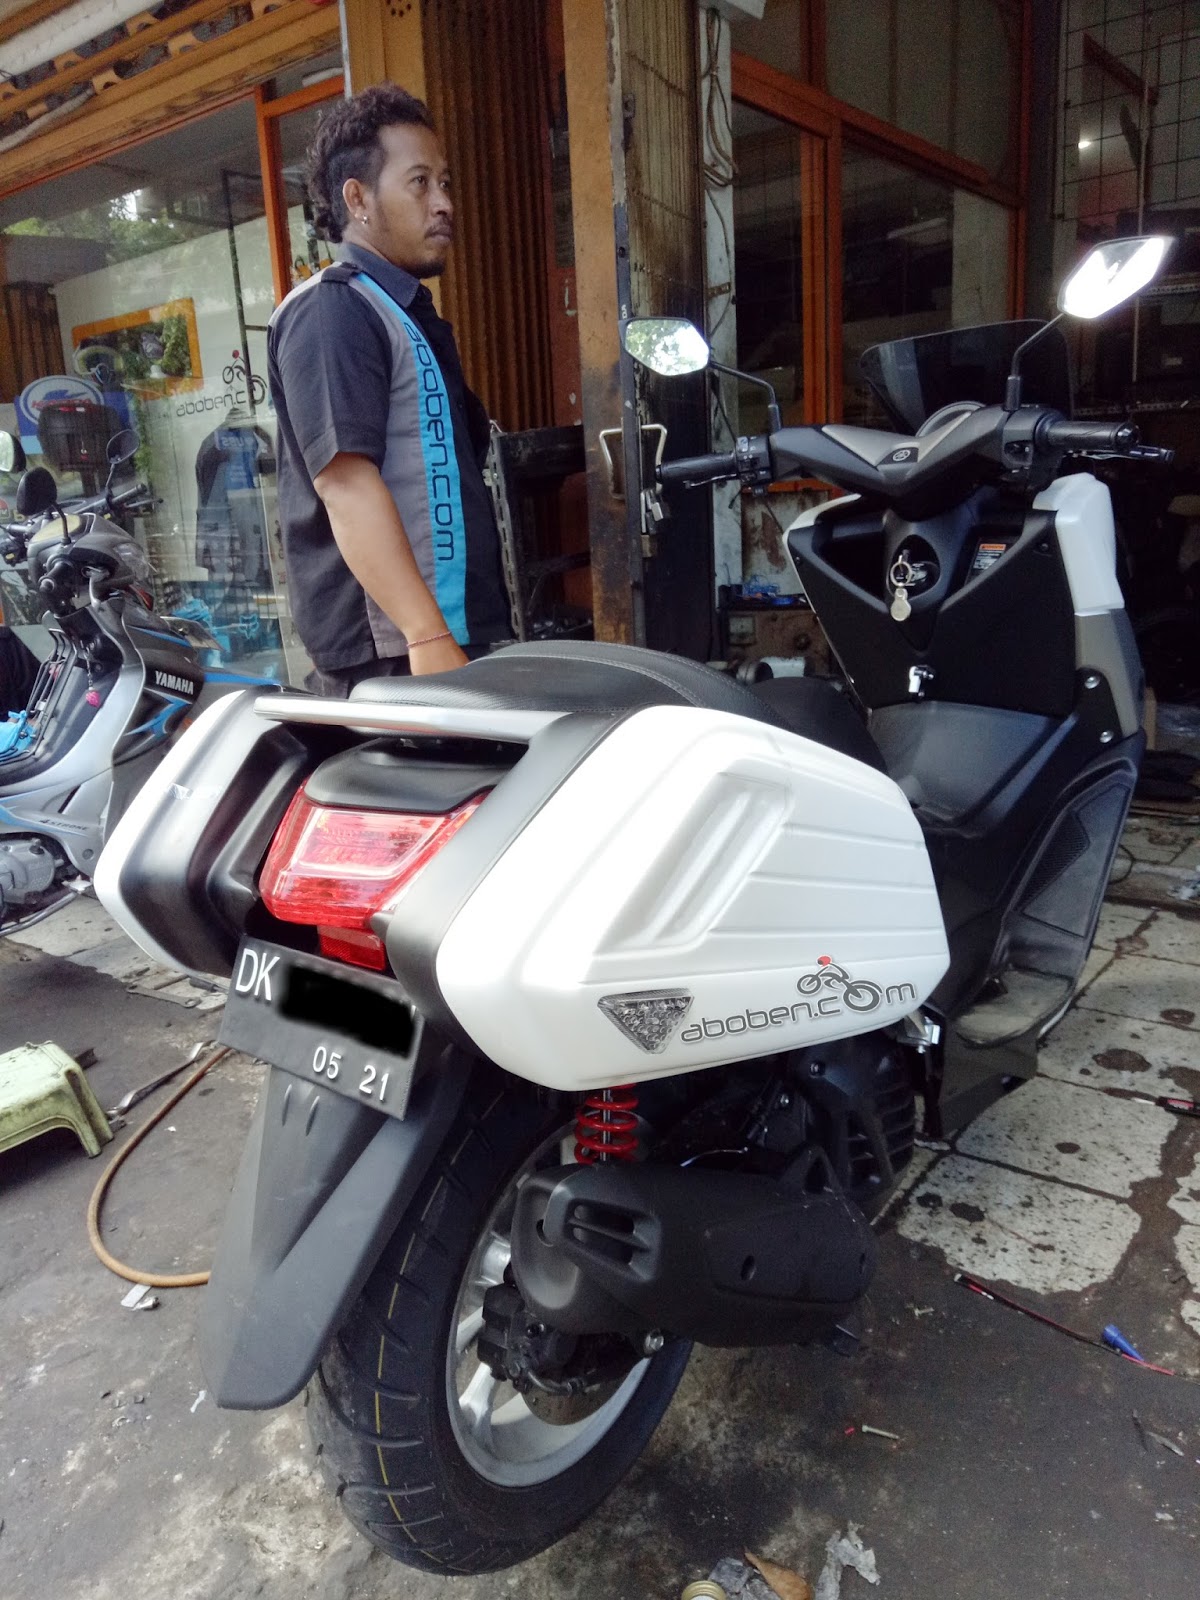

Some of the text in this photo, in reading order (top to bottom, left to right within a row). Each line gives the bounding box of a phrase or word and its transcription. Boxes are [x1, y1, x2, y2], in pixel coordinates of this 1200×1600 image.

[403, 321, 453, 561] aboben.com
[155, 670, 194, 695] YAMAHA
[235, 948, 280, 1001] DK
[681, 978, 916, 1042] aboben.com
[312, 1046, 389, 1101] 05 21
